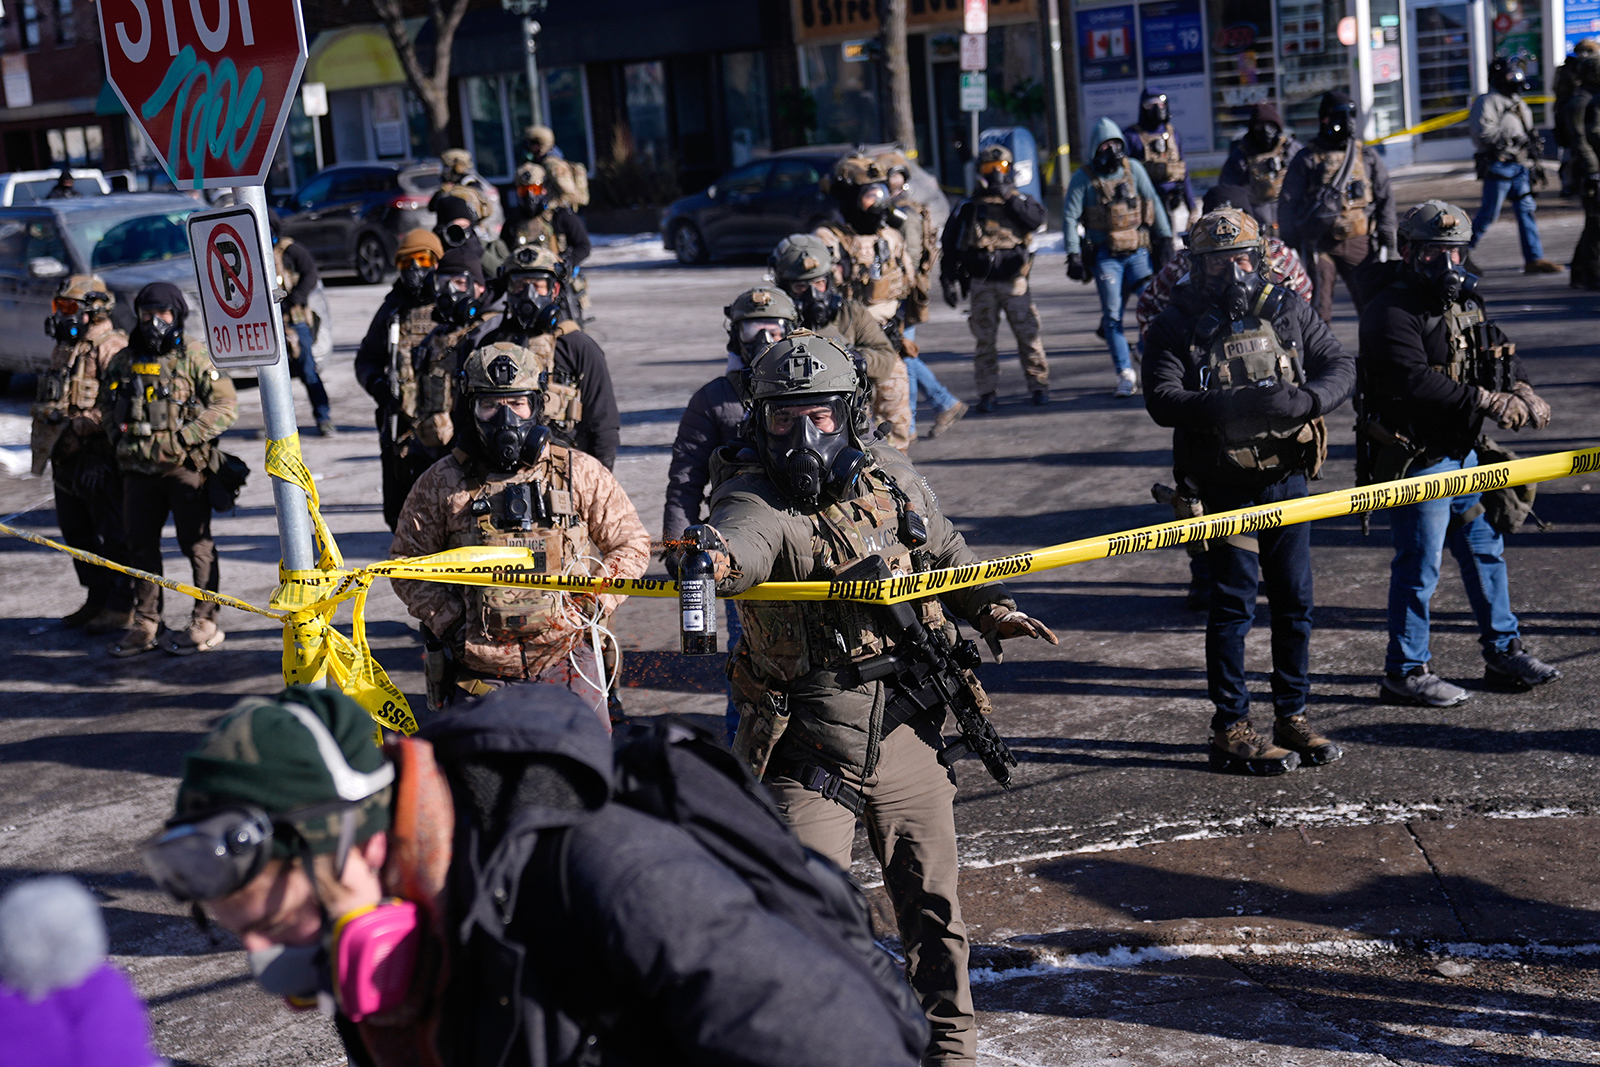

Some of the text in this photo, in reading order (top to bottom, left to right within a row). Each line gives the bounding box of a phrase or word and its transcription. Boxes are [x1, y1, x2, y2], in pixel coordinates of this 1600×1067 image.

[213, 322, 270, 354] 30 FEET
[1226, 337, 1269, 356] POLICE
[131, 363, 162, 375] POLICE
[1349, 467, 1509, 513] POLICE LINE DO NOT CROSS
[509, 539, 545, 551] POLICE
[863, 527, 900, 553] LICE
[1107, 507, 1283, 557] POLICE LINE DO NOT CROSS
[491, 572, 551, 586] POLICE
[557, 576, 596, 588] LINE
[631, 579, 669, 591] NOT
[827, 553, 1033, 600] POLICE LINE DO NOT CROSS
